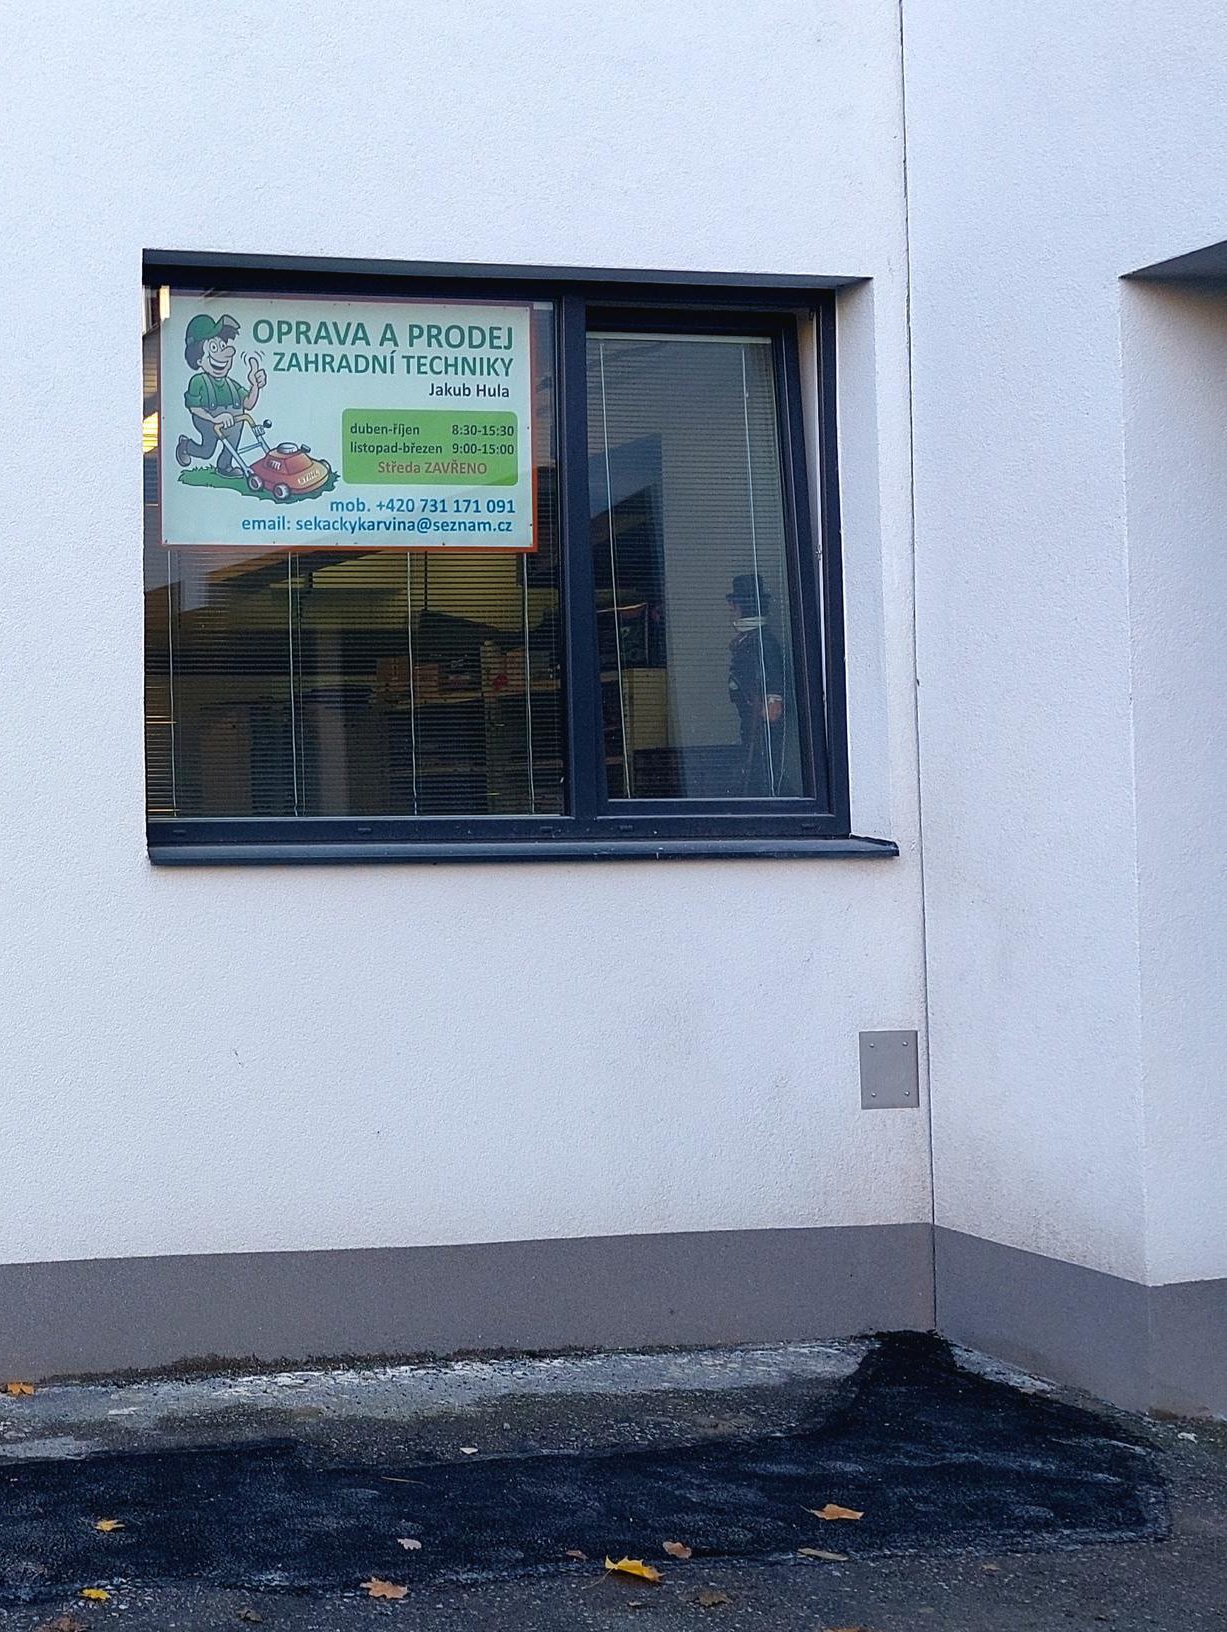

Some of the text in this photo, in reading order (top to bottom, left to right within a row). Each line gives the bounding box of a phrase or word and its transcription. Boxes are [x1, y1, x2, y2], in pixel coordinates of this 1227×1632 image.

[252, 319, 513, 350] OPRAVA A PRODEJ
[272, 349, 514, 377] ZAHRADNÍ TECHNIKY
[428, 383, 510, 399] Jakub Hula
[350, 423, 515, 439] duben-říjen 8:30-15:30
[350, 441, 515, 457] listopad-březen 9:00-15:00
[378, 460, 487, 475] Středa ZAVŘENO
[330, 498, 516, 513] mob. +420 731 171 091
[241, 516, 512, 534] email: sekackykarvina@seznam.cz
